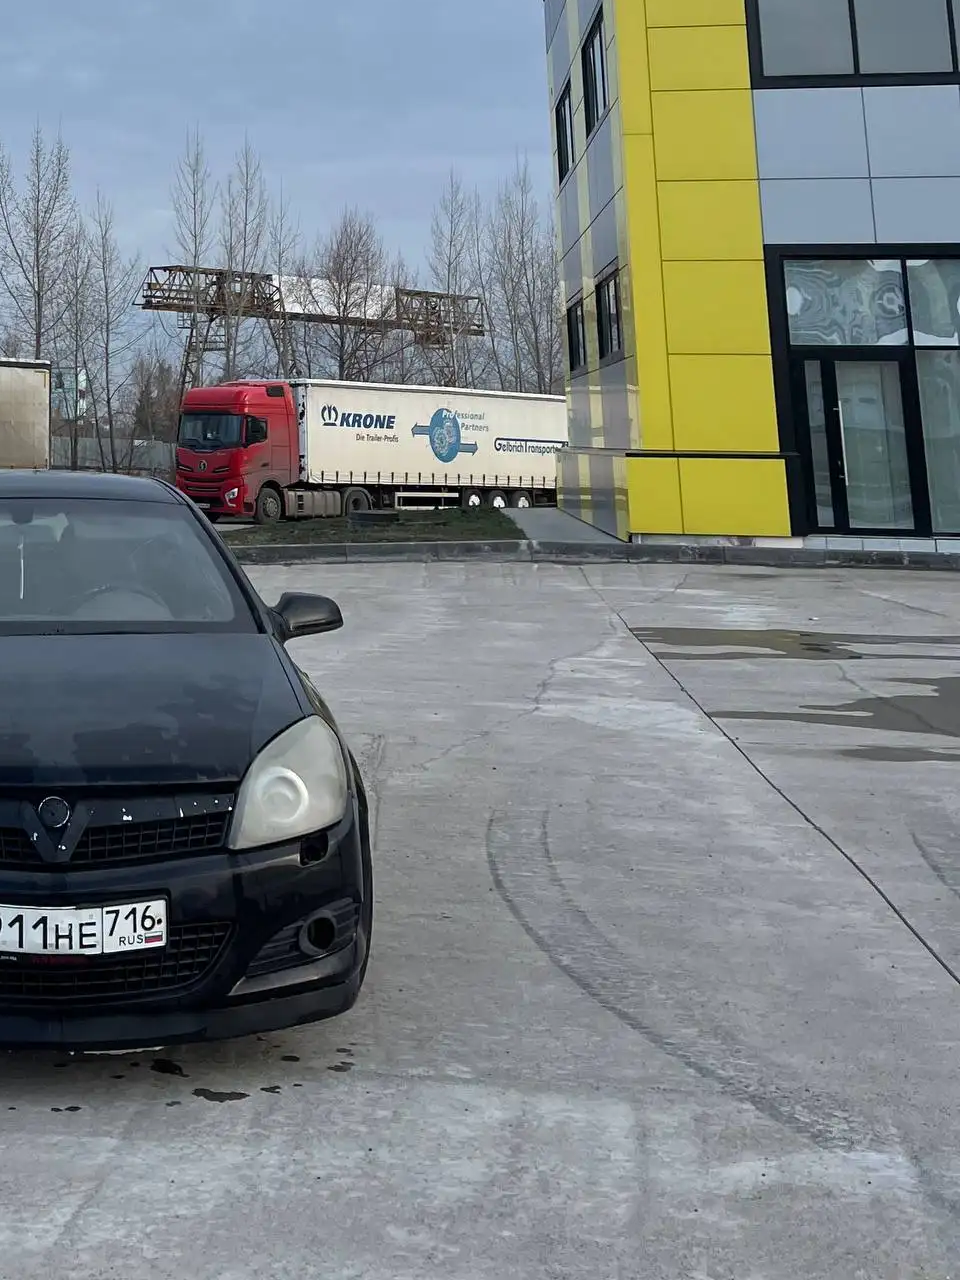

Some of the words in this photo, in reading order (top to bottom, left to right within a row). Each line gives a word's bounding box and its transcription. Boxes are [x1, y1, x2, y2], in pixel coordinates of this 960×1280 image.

[340, 412, 396, 430] KRONE
[442, 409, 485, 421] Professional
[460, 422, 489, 432] Partners
[355, 433, 365, 441] Die
[366, 434, 399, 443] Trailer-Profis
[105, 905, 156, 937] 716
[119, 934, 144, 946] RUS
